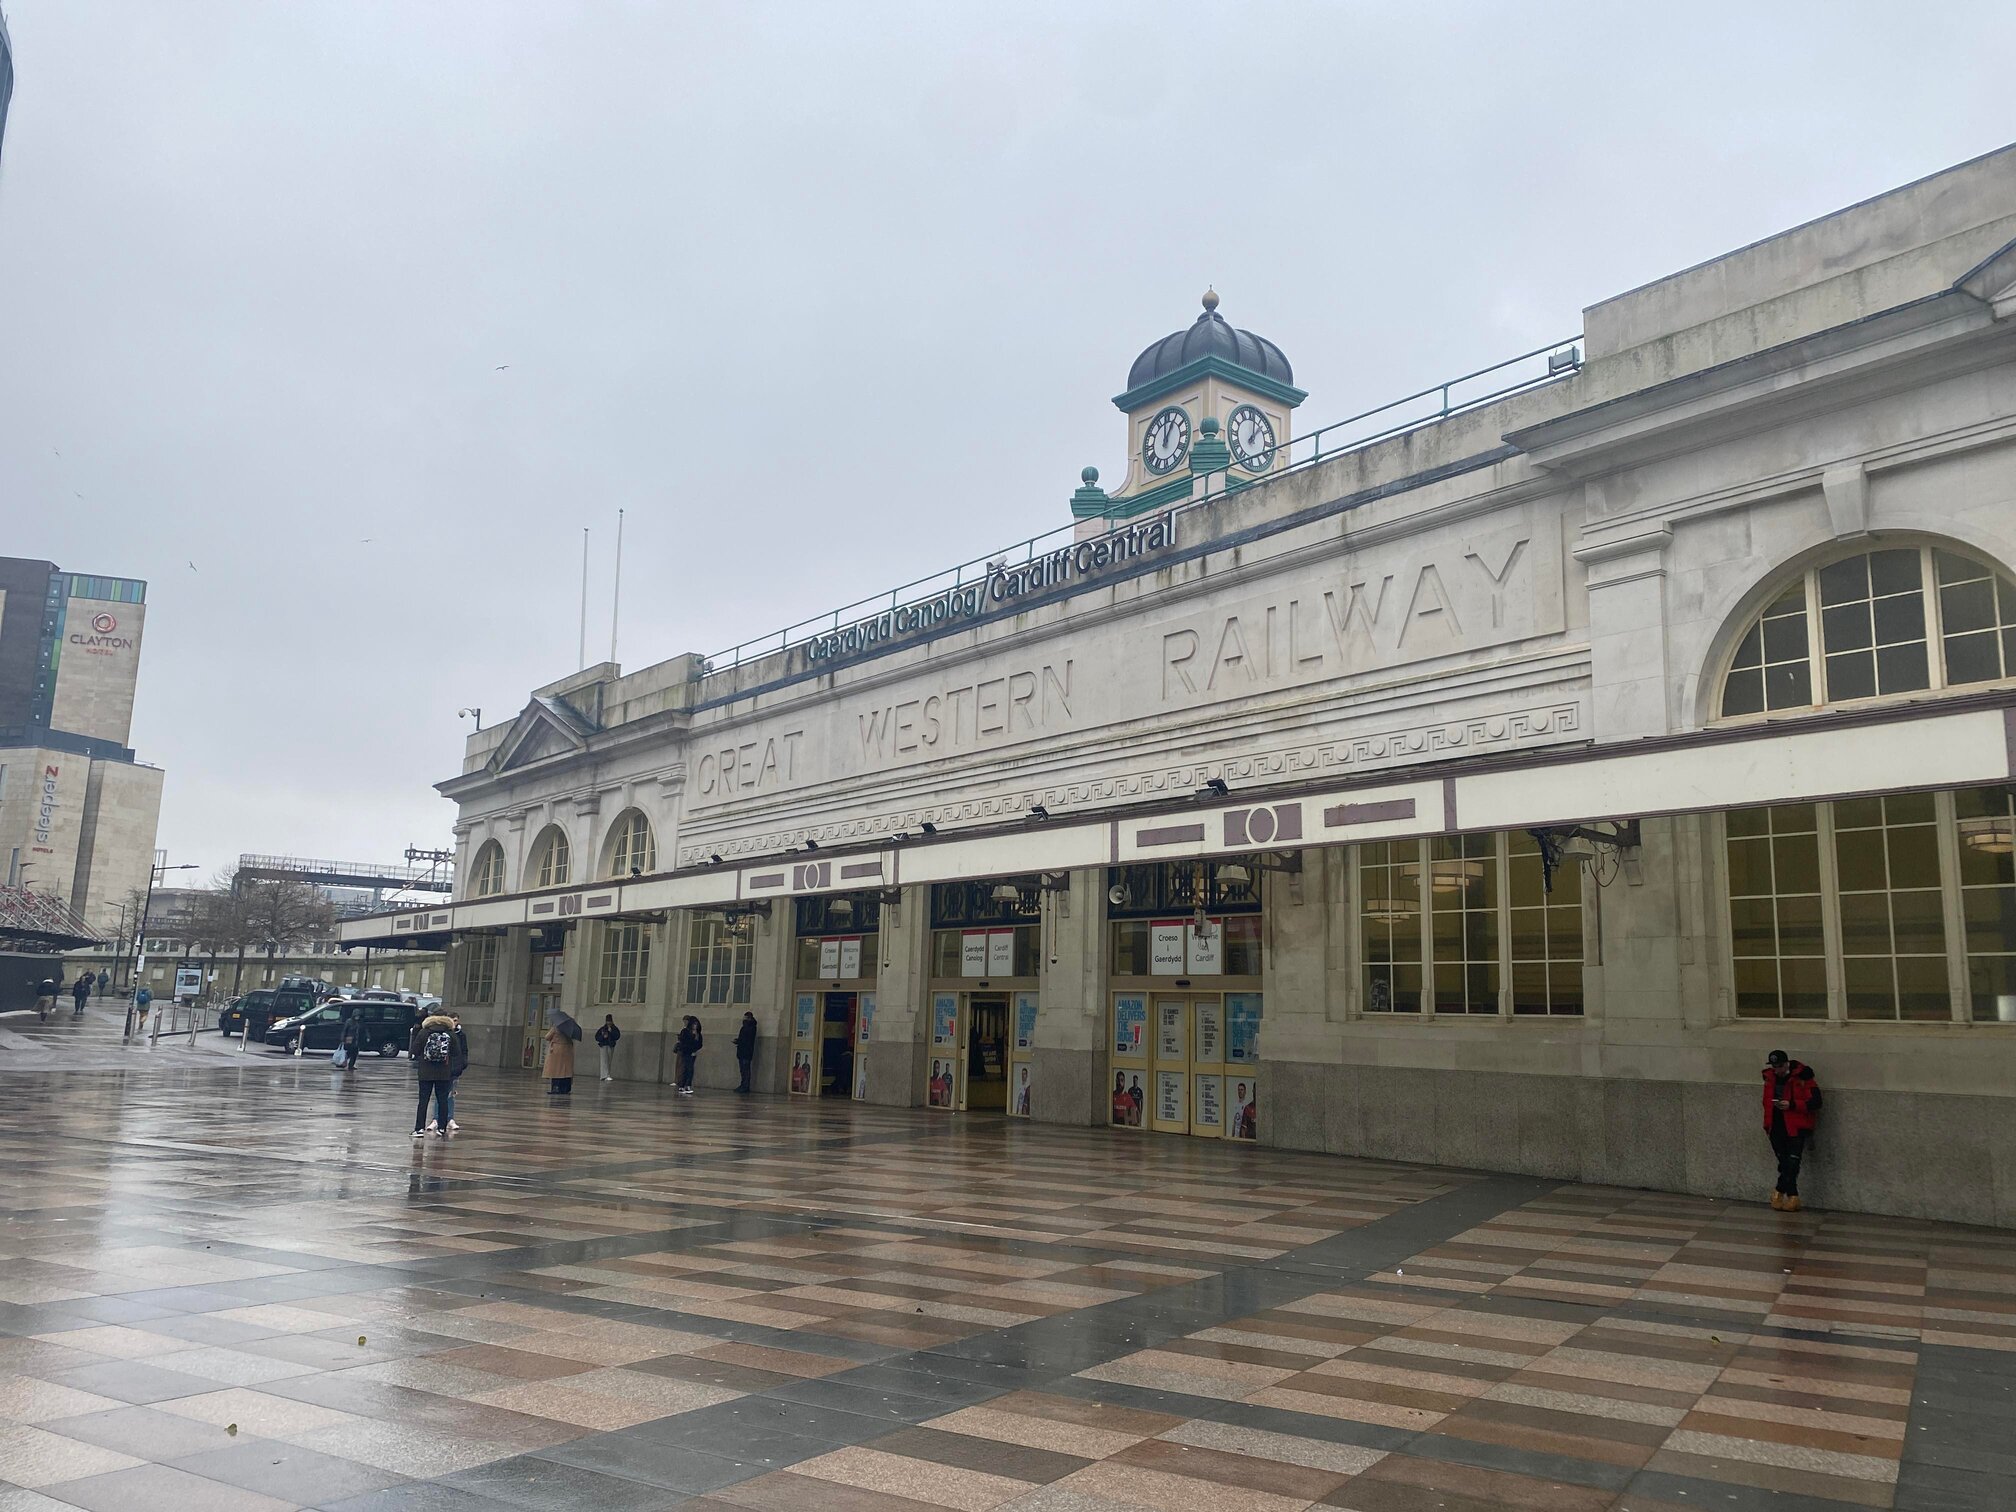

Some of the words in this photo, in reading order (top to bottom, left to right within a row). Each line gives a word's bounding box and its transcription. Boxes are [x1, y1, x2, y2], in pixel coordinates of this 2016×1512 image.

[808, 611, 894, 662] Caerdydd
[1075, 510, 1176, 575] Central
[70, 634, 133, 648] CLAYTON
[858, 659, 1074, 763] WESTERN
[1161, 538, 1531, 700] RAILWAY
[1158, 934, 1179, 942] Croeso
[1154, 955, 1182, 964] Gaerdydd
[1195, 954, 1215, 962] Cardiff
[1117, 999, 1143, 1011] AMAZON
[1117, 1010, 1146, 1021] DELIVERS
[1117, 1021, 1129, 1032] THE
